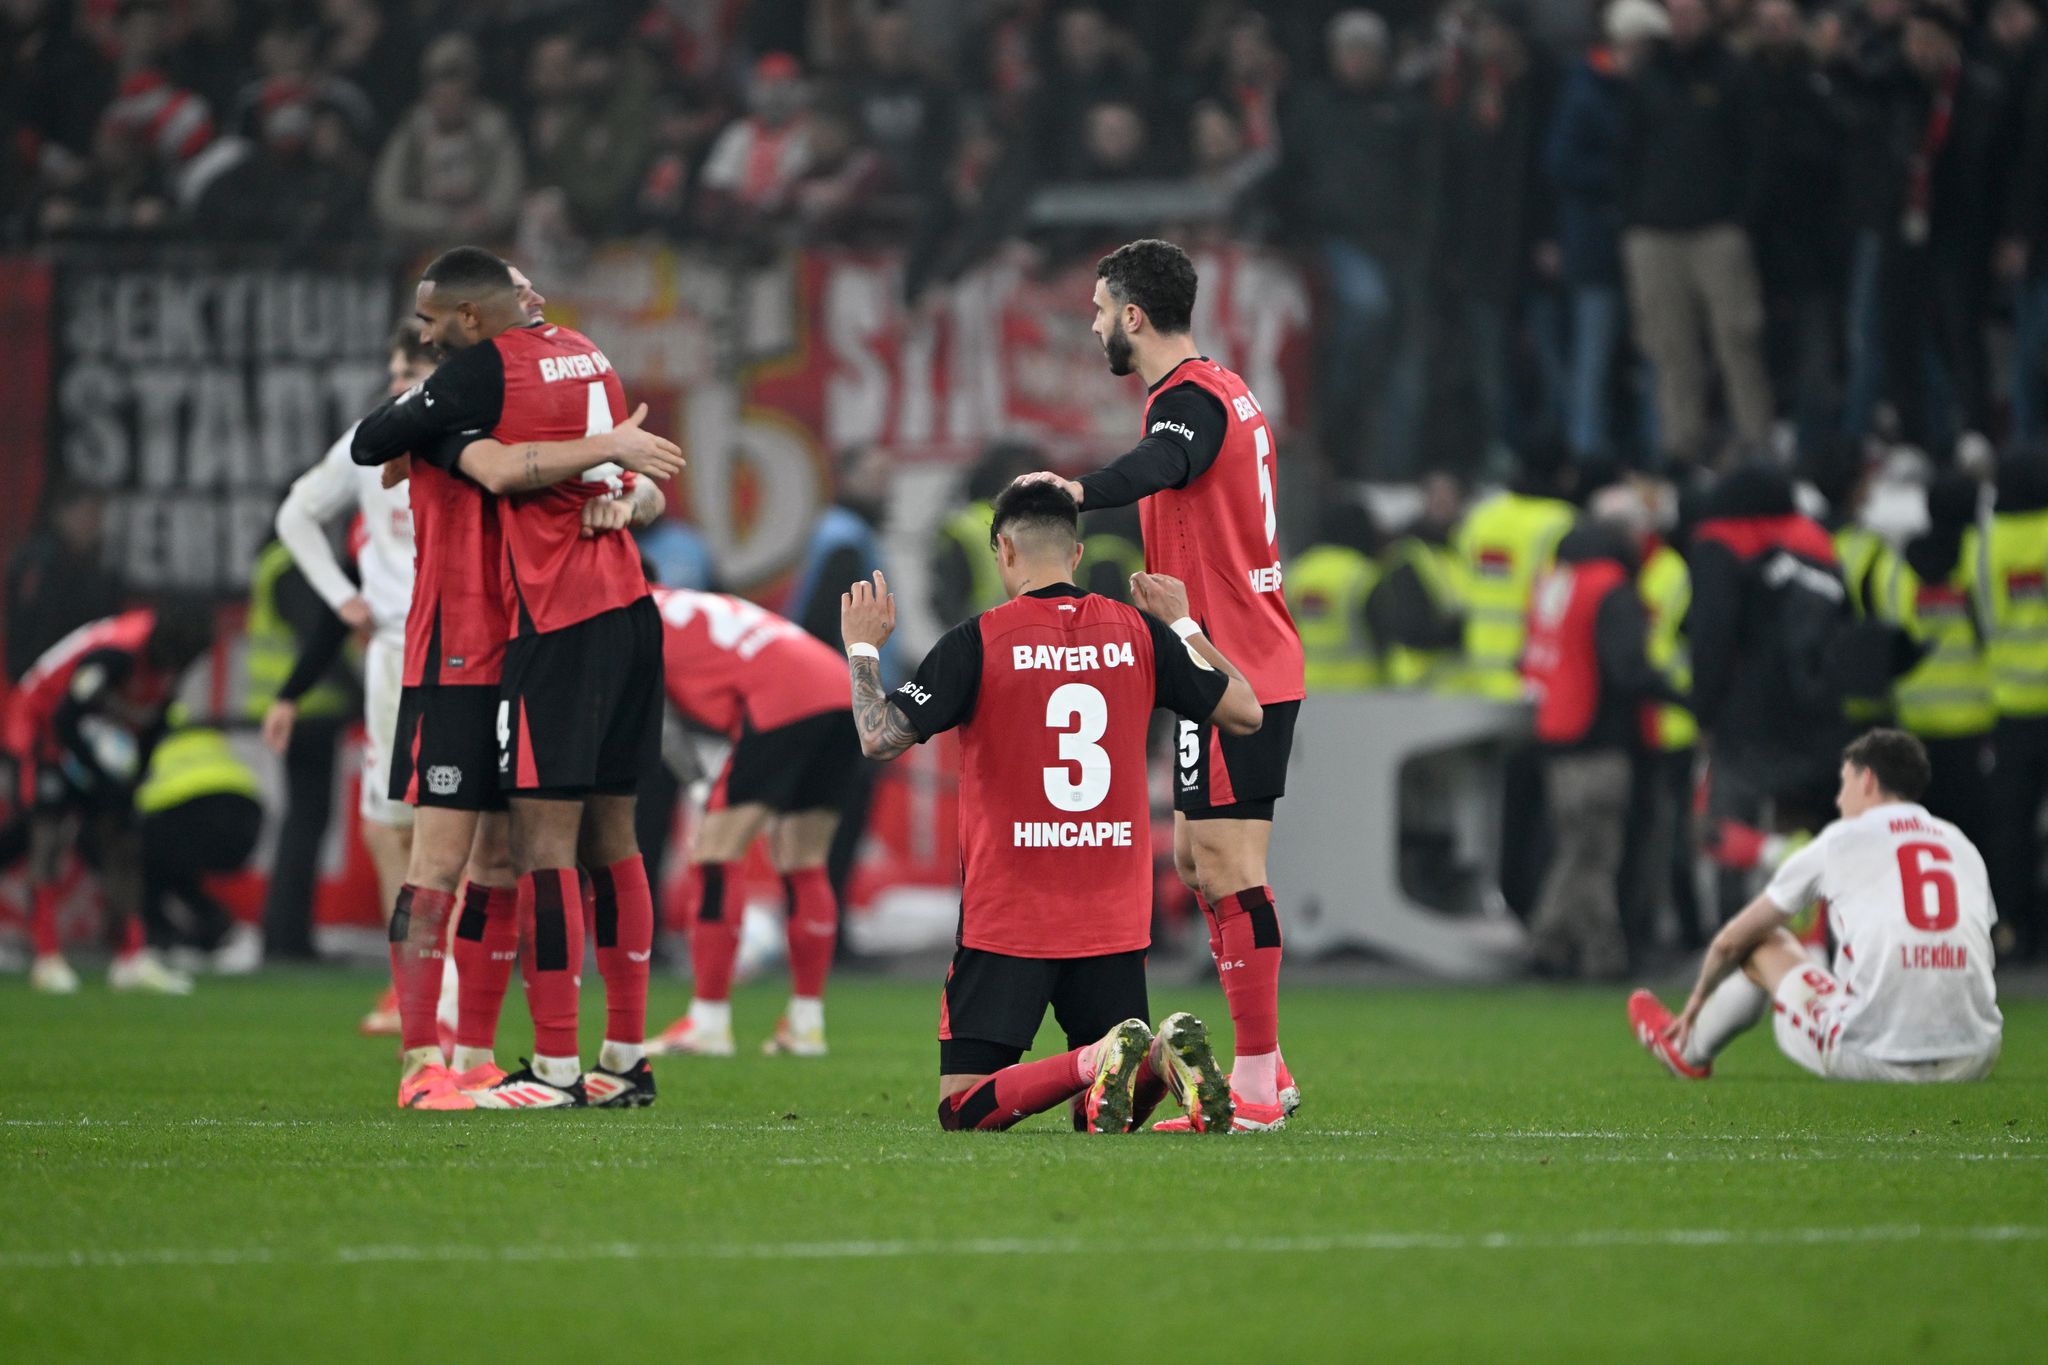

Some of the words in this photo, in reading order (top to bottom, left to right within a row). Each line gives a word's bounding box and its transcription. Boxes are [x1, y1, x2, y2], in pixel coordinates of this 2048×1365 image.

[539, 354, 597, 383] BAYER
[1012, 645, 1100, 671] BAYER
[1102, 642, 1135, 668] 04
[1043, 683, 1112, 812] 3
[1179, 719, 1200, 769] 5
[1013, 821, 1132, 847] HINCAPIE
[1896, 841, 1959, 932] 6
[1914, 944, 1930, 969] FC
